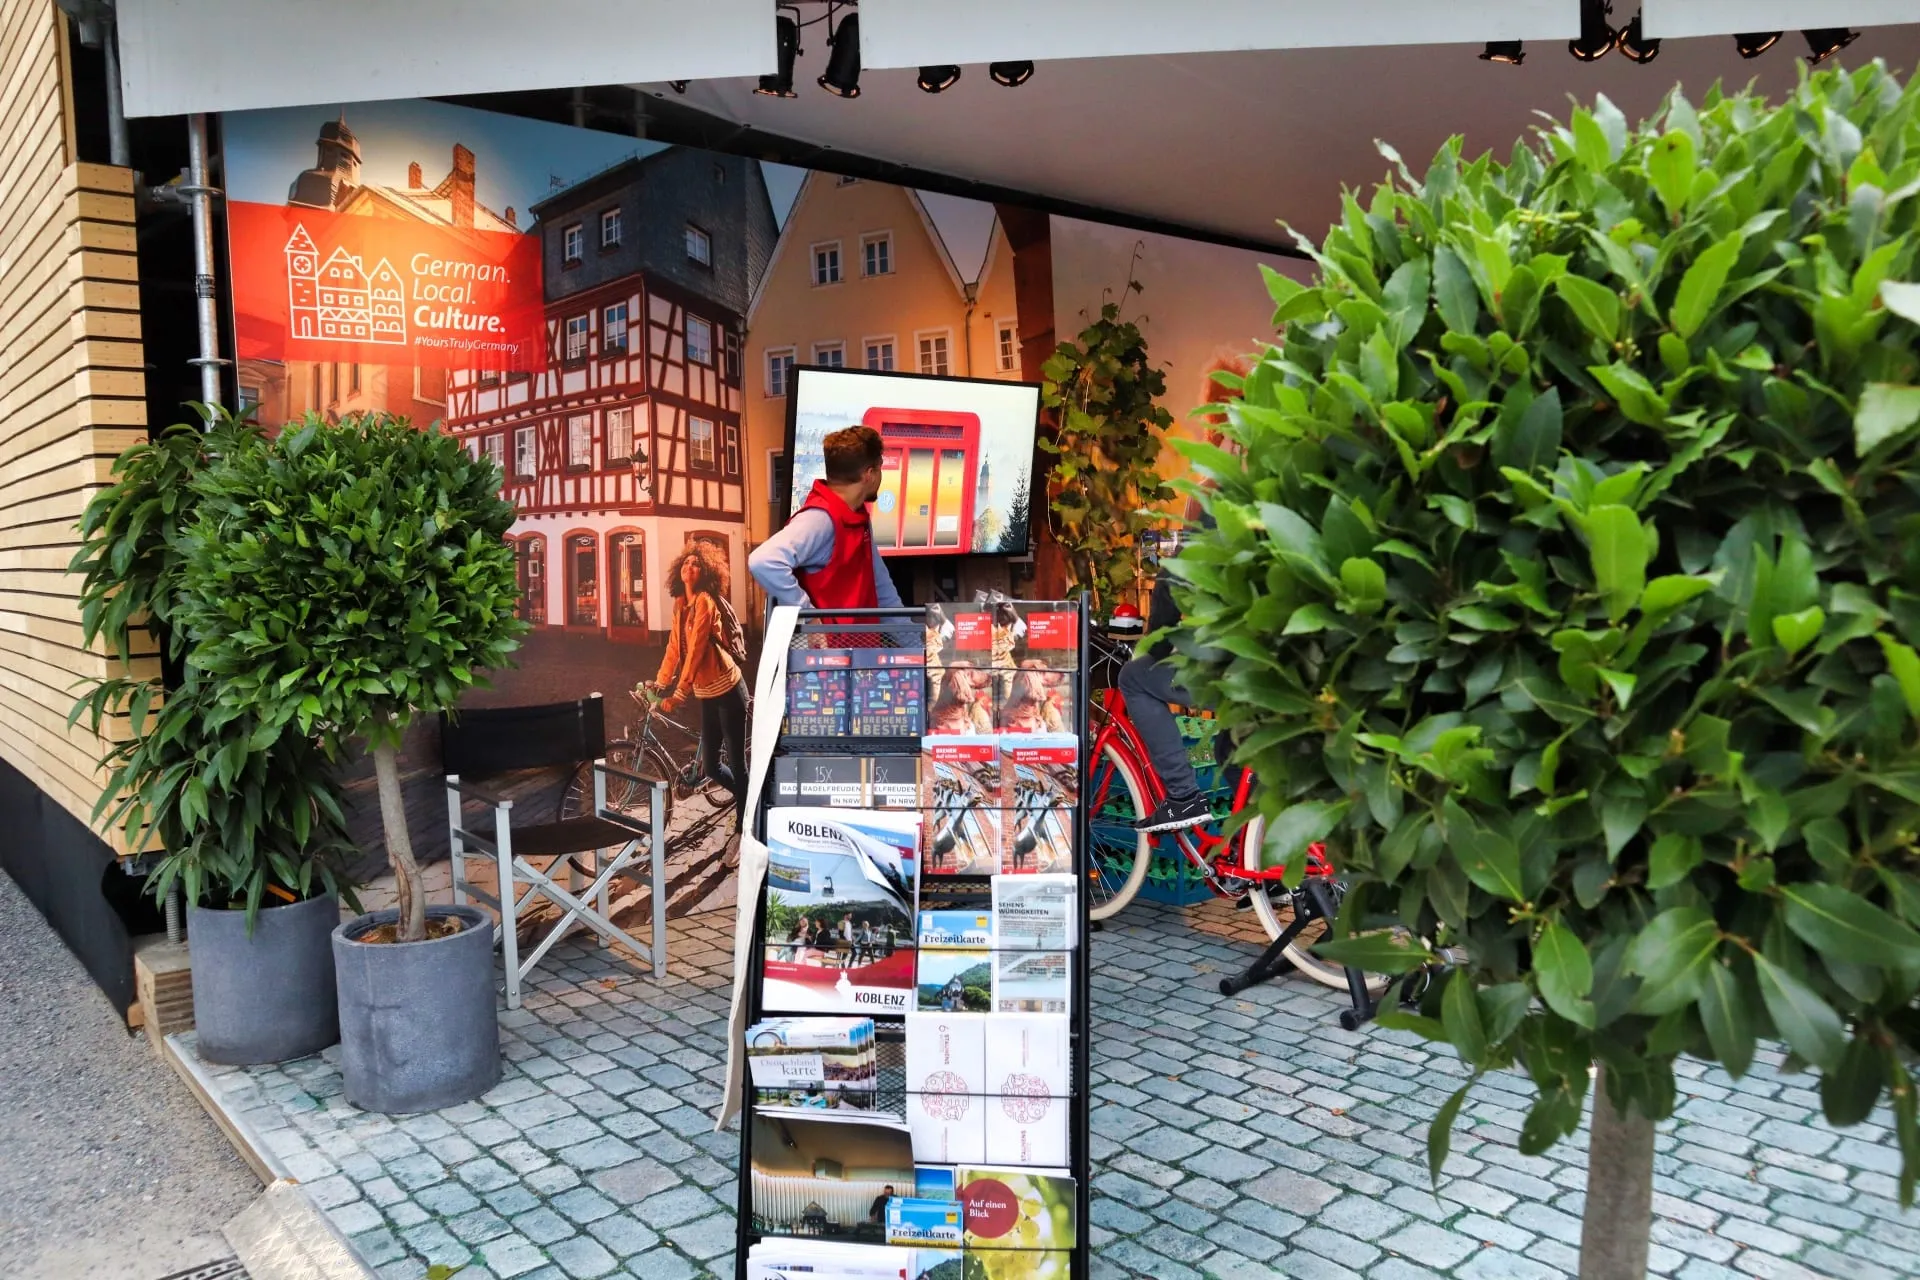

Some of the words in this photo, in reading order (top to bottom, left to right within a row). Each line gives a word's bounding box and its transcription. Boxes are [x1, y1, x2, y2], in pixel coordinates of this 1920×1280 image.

[411, 253, 511, 283] German.
[413, 278, 476, 304] Local.
[415, 305, 506, 333] Culture.
[415, 336, 519, 354] #YoursTrulyGermany
[791, 716, 836, 724] BREMENS
[863, 716, 908, 724] BREMENS
[791, 725, 836, 735] BESTE
[863, 725, 908, 735] BESTE
[802, 784, 861, 792] RADELFREUDEN
[788, 820, 845, 841] KOBLENZ
[924, 934, 986, 944] Freizeitkarte
[855, 992, 906, 1006] KOBLENZ
[782, 1064, 817, 1076] karte
[969, 1199, 984, 1210] Auf
[985, 1201, 1007, 1210] einen
[969, 1208, 990, 1219] Blick
[892, 1228, 957, 1240] Freizeitkarte
